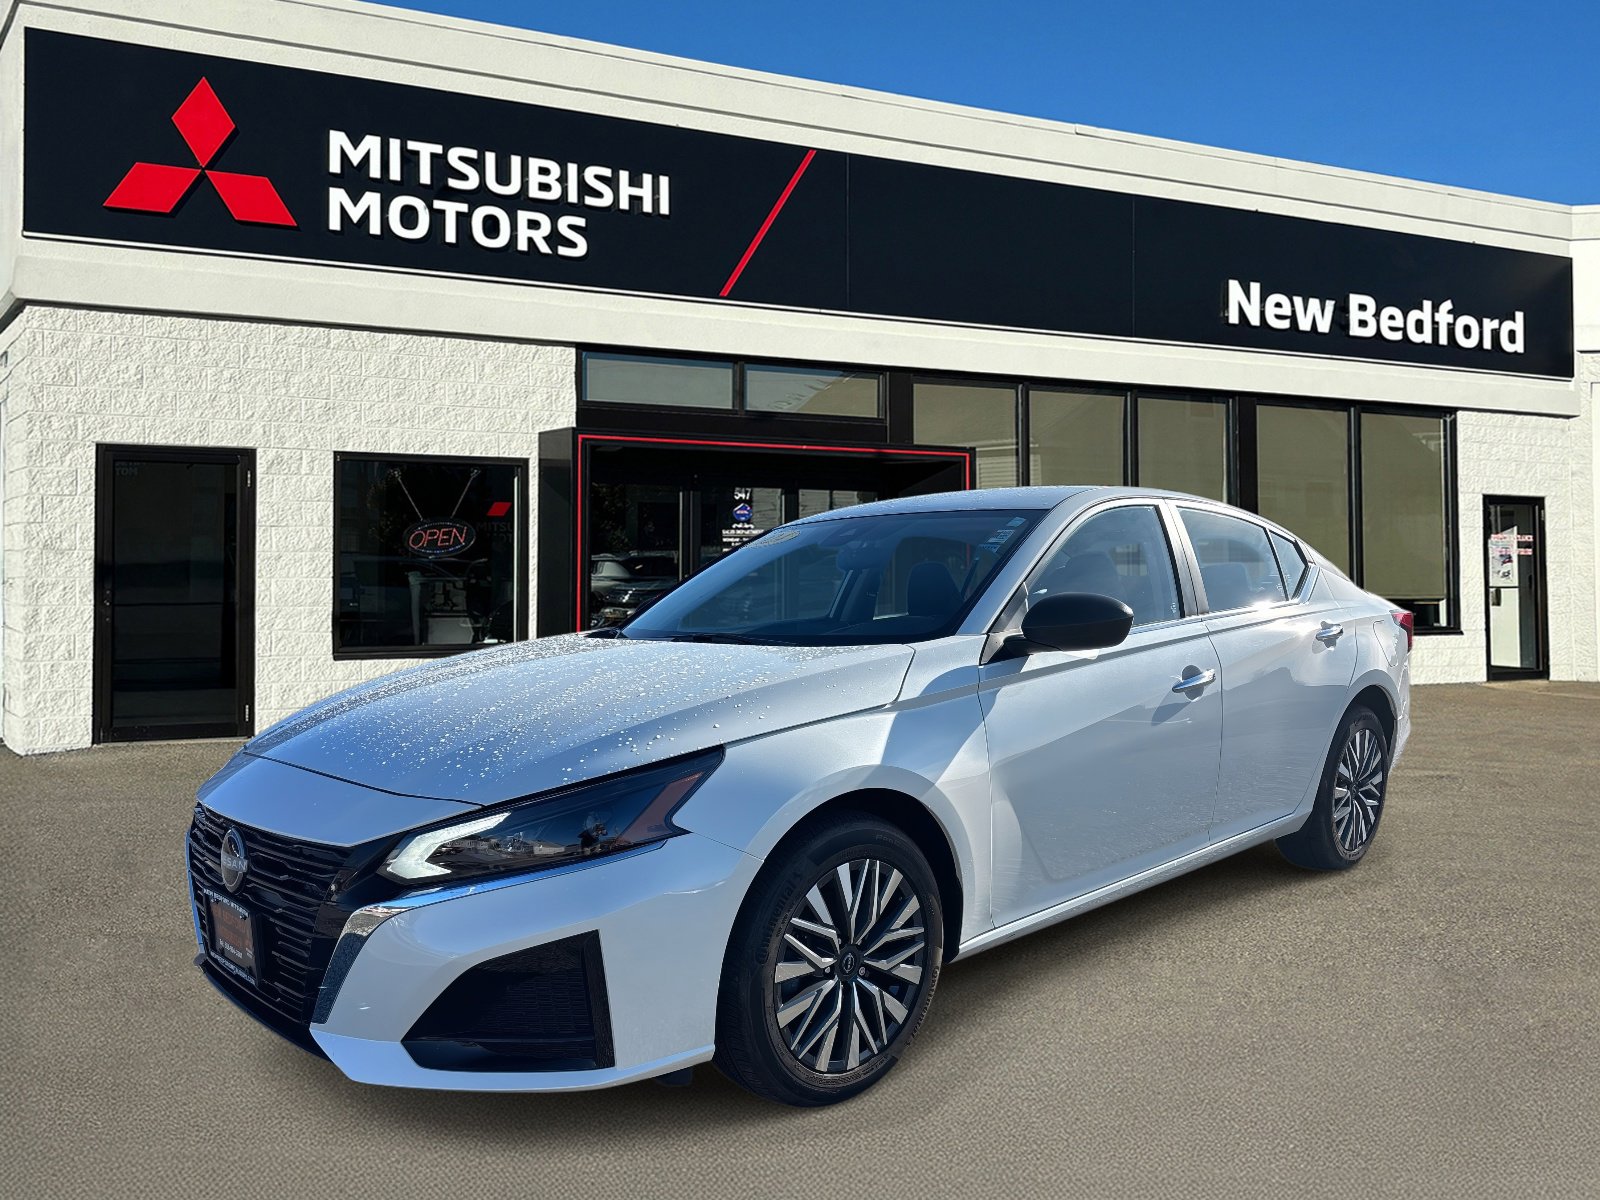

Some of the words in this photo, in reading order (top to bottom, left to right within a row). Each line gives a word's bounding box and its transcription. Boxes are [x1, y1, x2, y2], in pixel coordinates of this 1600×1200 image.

[328, 129, 670, 216] MITSUBISHI
[328, 187, 589, 258] MOTORS
[1227, 279, 1336, 333] New
[1348, 293, 1526, 354] Bedford
[733, 487, 752, 500] 547
[409, 526, 467, 549] OPEN
